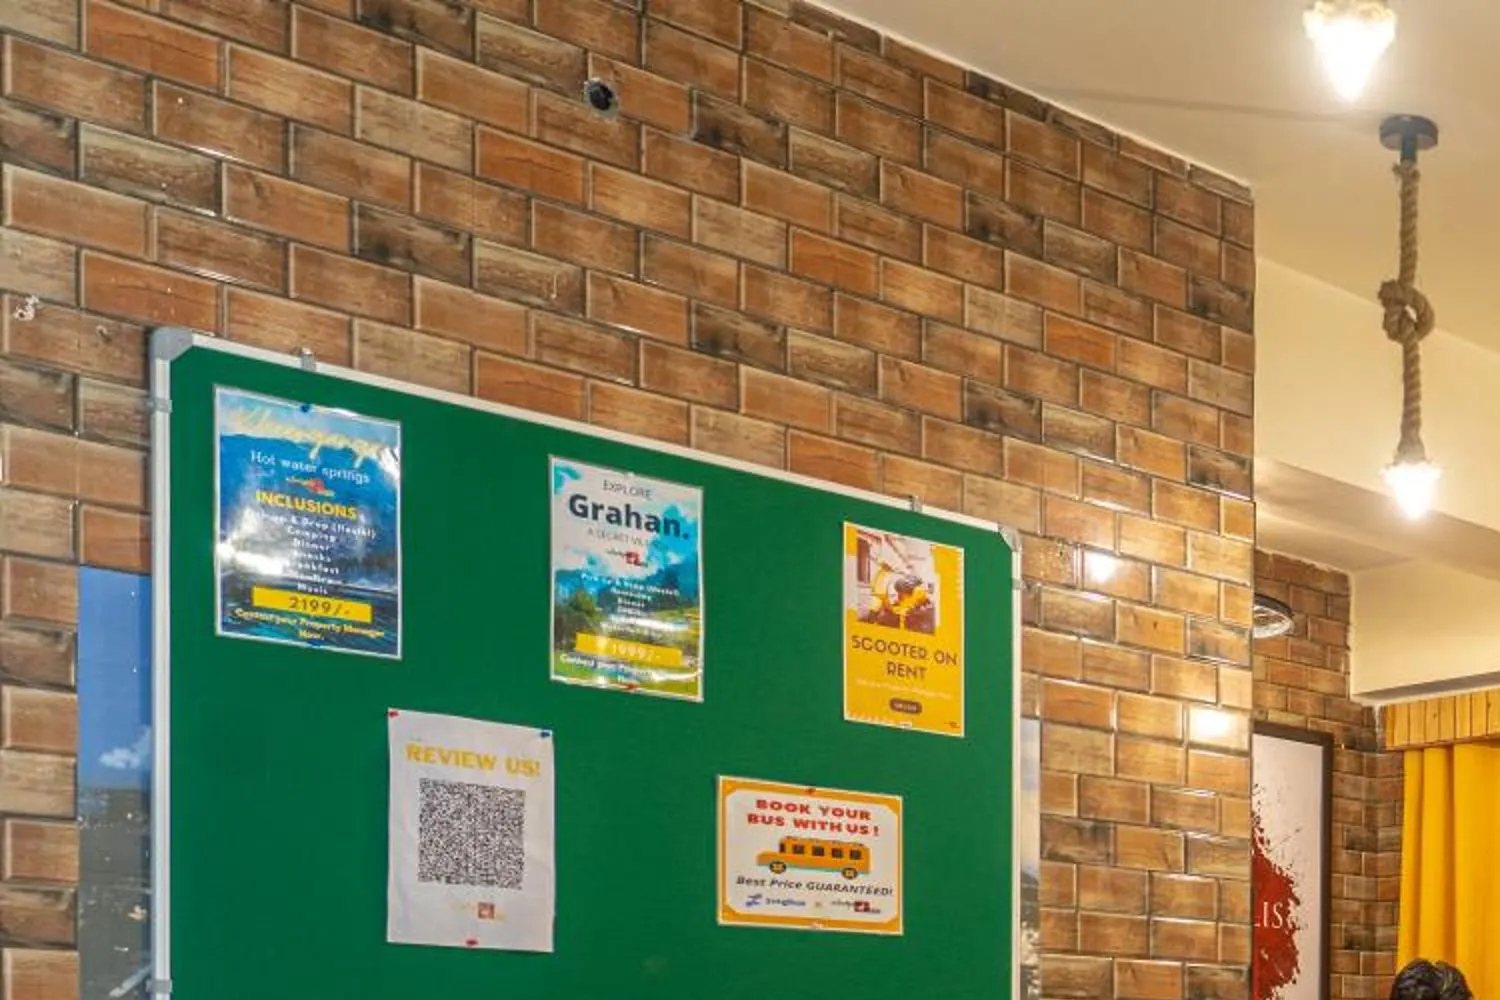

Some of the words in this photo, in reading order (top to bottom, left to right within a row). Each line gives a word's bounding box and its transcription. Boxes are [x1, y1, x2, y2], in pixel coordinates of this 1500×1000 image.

[250, 449, 276, 466] Hot
[280, 459, 318, 474] water
[321, 466, 371, 486] springs
[602, 479, 654, 499] EXPLORE
[255, 488, 357, 520] INCLUSIONS
[568, 493, 690, 540] Grahan.
[288, 594, 350, 616] 2199/-
[851, 634, 928, 660] SCOOTER
[933, 649, 958, 666] ON
[887, 661, 928, 680] RENT
[405, 742, 497, 770] REVIEW
[505, 755, 541, 777] US!
[756, 799, 811, 815] BOOK
[819, 805, 872, 821] YOUR
[747, 812, 785, 827] BUS
[793, 817, 843, 833] WITH
[736, 875, 766, 887] Best
[769, 878, 803, 890] Price
